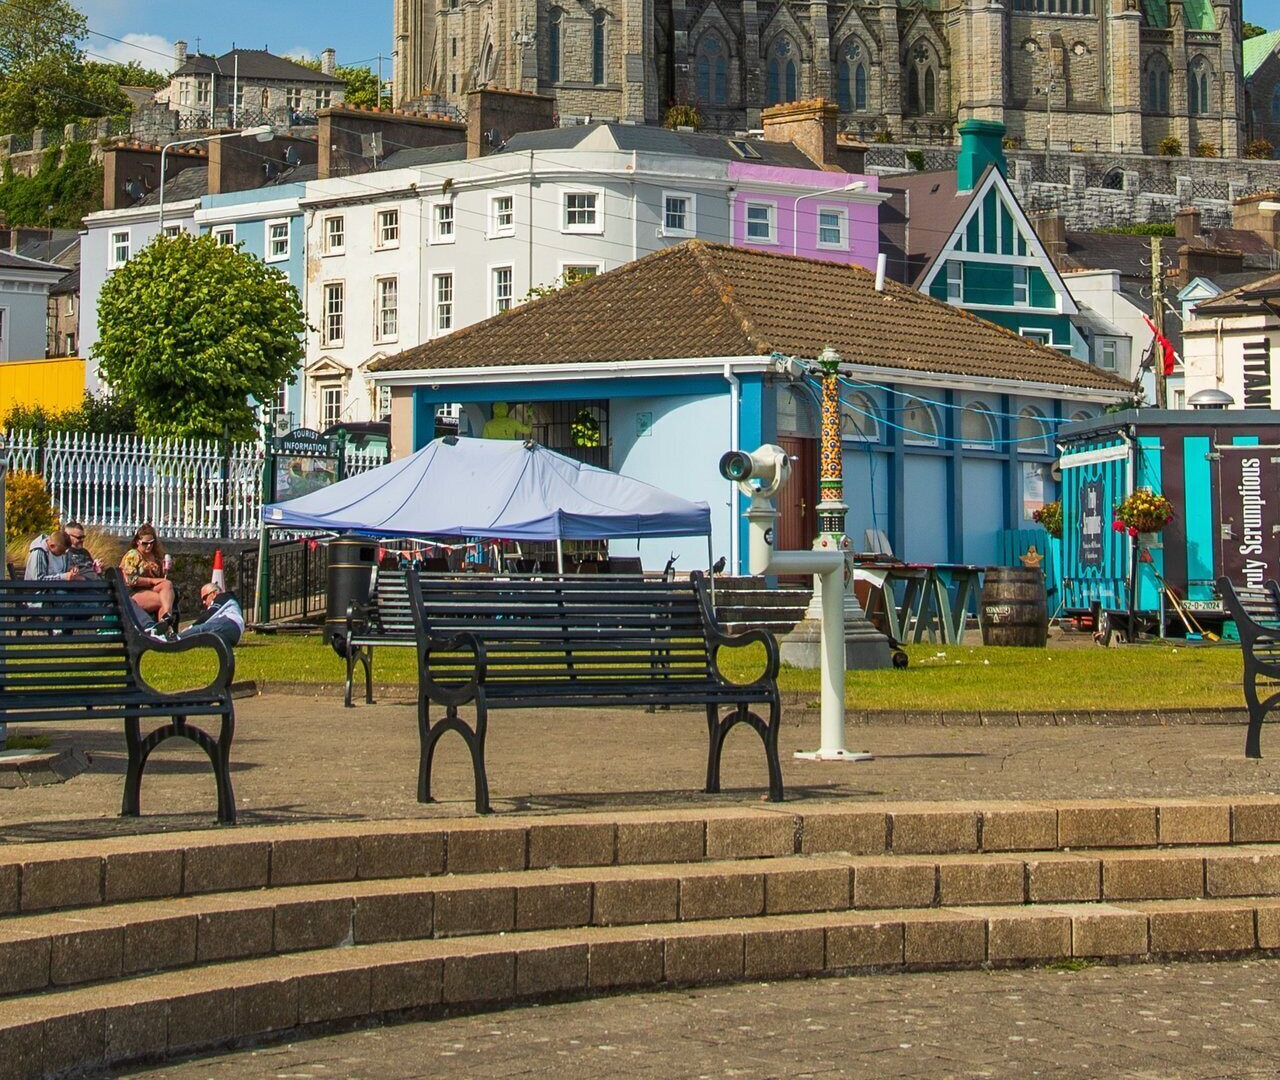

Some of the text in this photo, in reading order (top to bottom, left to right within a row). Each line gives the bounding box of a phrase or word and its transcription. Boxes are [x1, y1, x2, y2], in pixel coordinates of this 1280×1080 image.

[1243, 337, 1271, 410] TITANI
[284, 441, 328, 451] INFORMATION
[293, 430, 318, 440] TOURIST
[1238, 458, 1266, 555] Scrumptious
